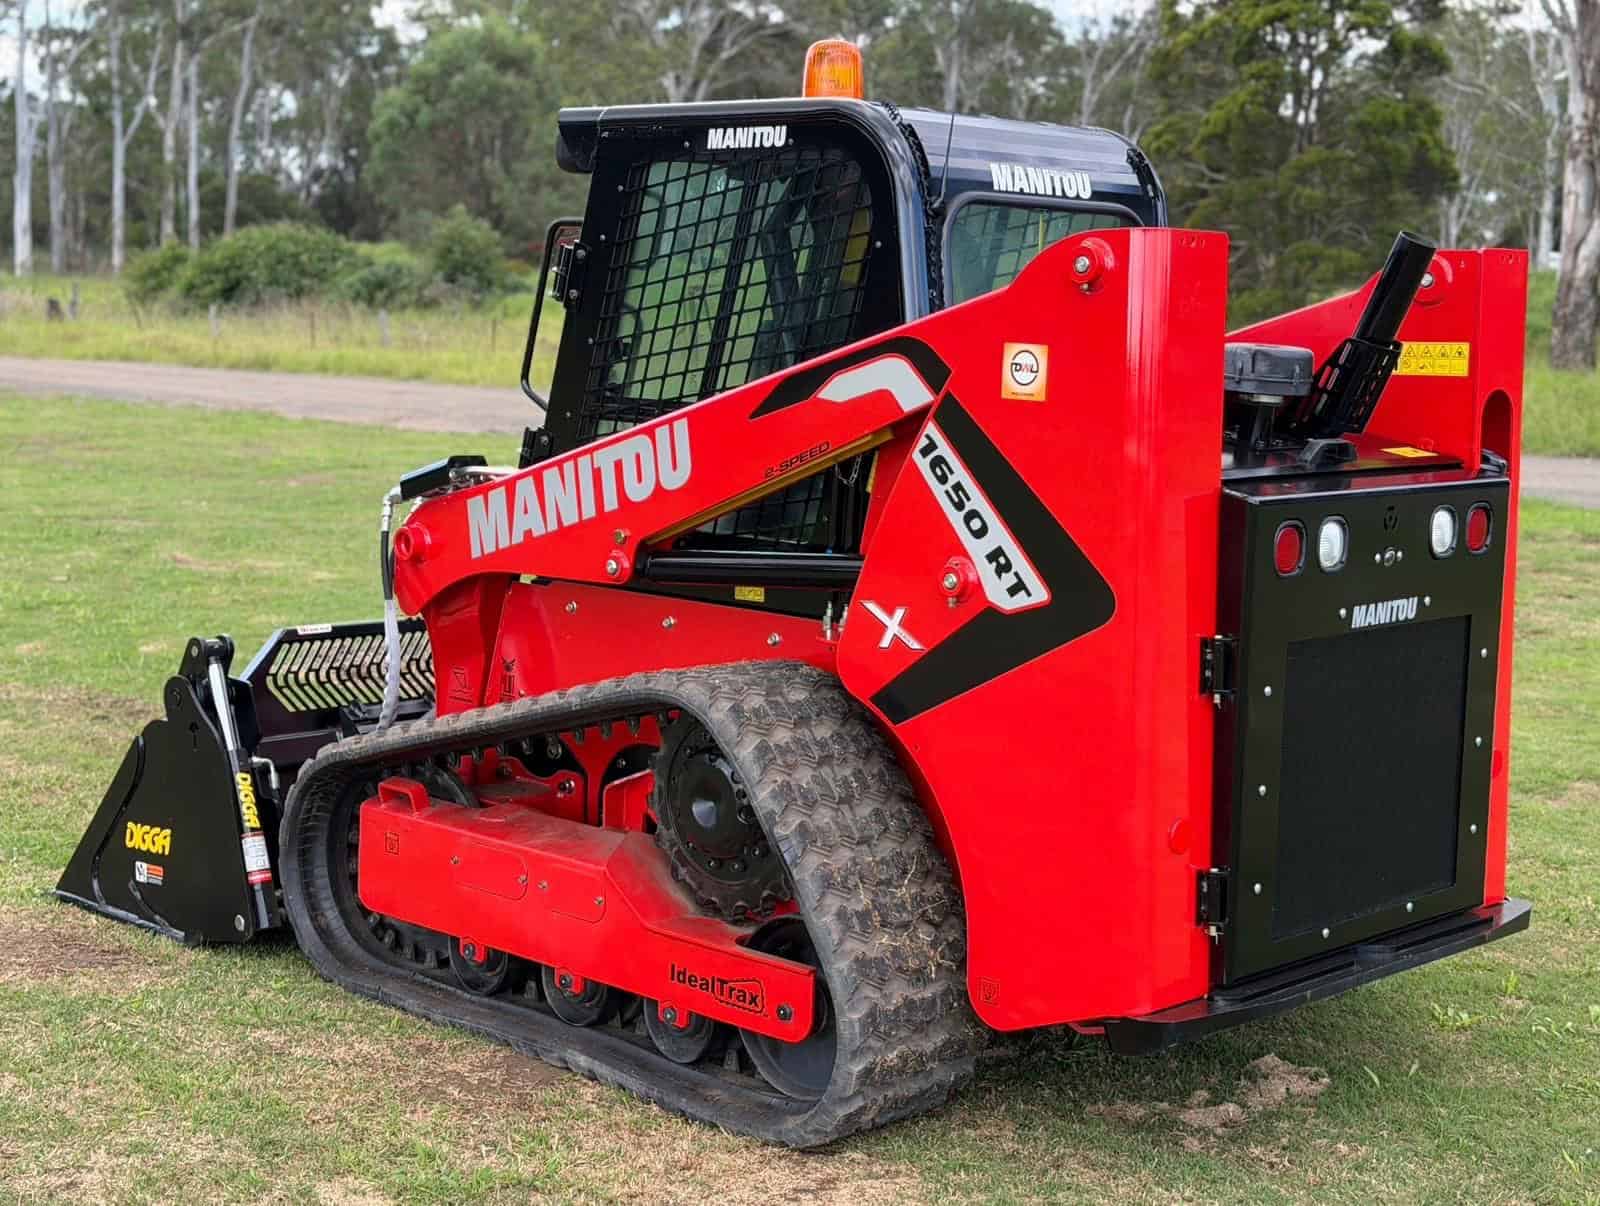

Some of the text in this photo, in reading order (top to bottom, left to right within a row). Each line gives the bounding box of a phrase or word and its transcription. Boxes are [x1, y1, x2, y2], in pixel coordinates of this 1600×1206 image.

[707, 125, 787, 150] MANITOU
[990, 162, 1092, 199] MANITOU
[467, 417, 692, 560] MANITOU
[919, 433, 1032, 598] 1650 RT
[1351, 596, 1418, 629] MANITOU
[235, 771, 261, 829] DIGGA
[125, 821, 171, 855] DIGGA
[670, 963, 760, 1008] IdealTrax
